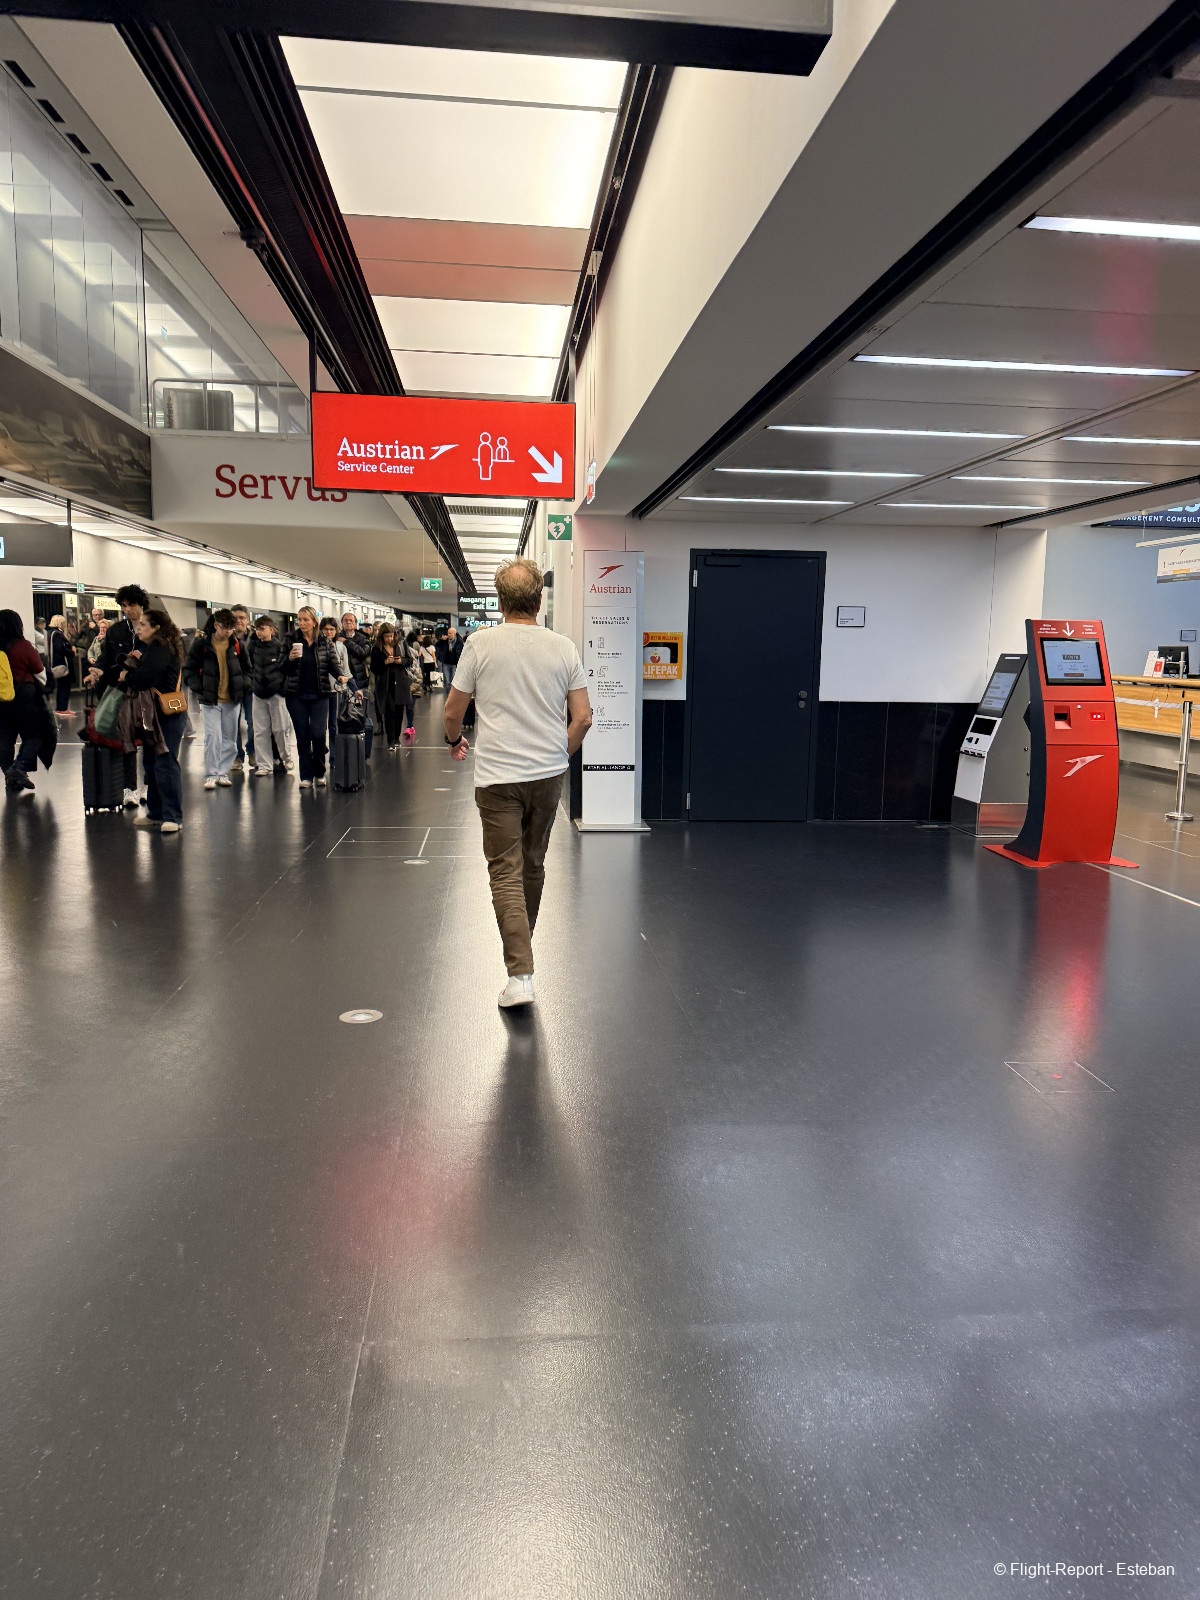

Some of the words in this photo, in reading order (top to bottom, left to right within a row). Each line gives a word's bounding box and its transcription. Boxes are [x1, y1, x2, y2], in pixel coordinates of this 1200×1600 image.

[336, 436, 425, 460] Austrian
[337, 461, 378, 473] Service
[379, 462, 414, 475] Center
[589, 583, 632, 594] Austrian
[460, 596, 486, 604] Ausgang
[588, 640, 593, 648] 1
[588, 669, 594, 677] 2
[643, 665, 678, 675] LIFEPAK
